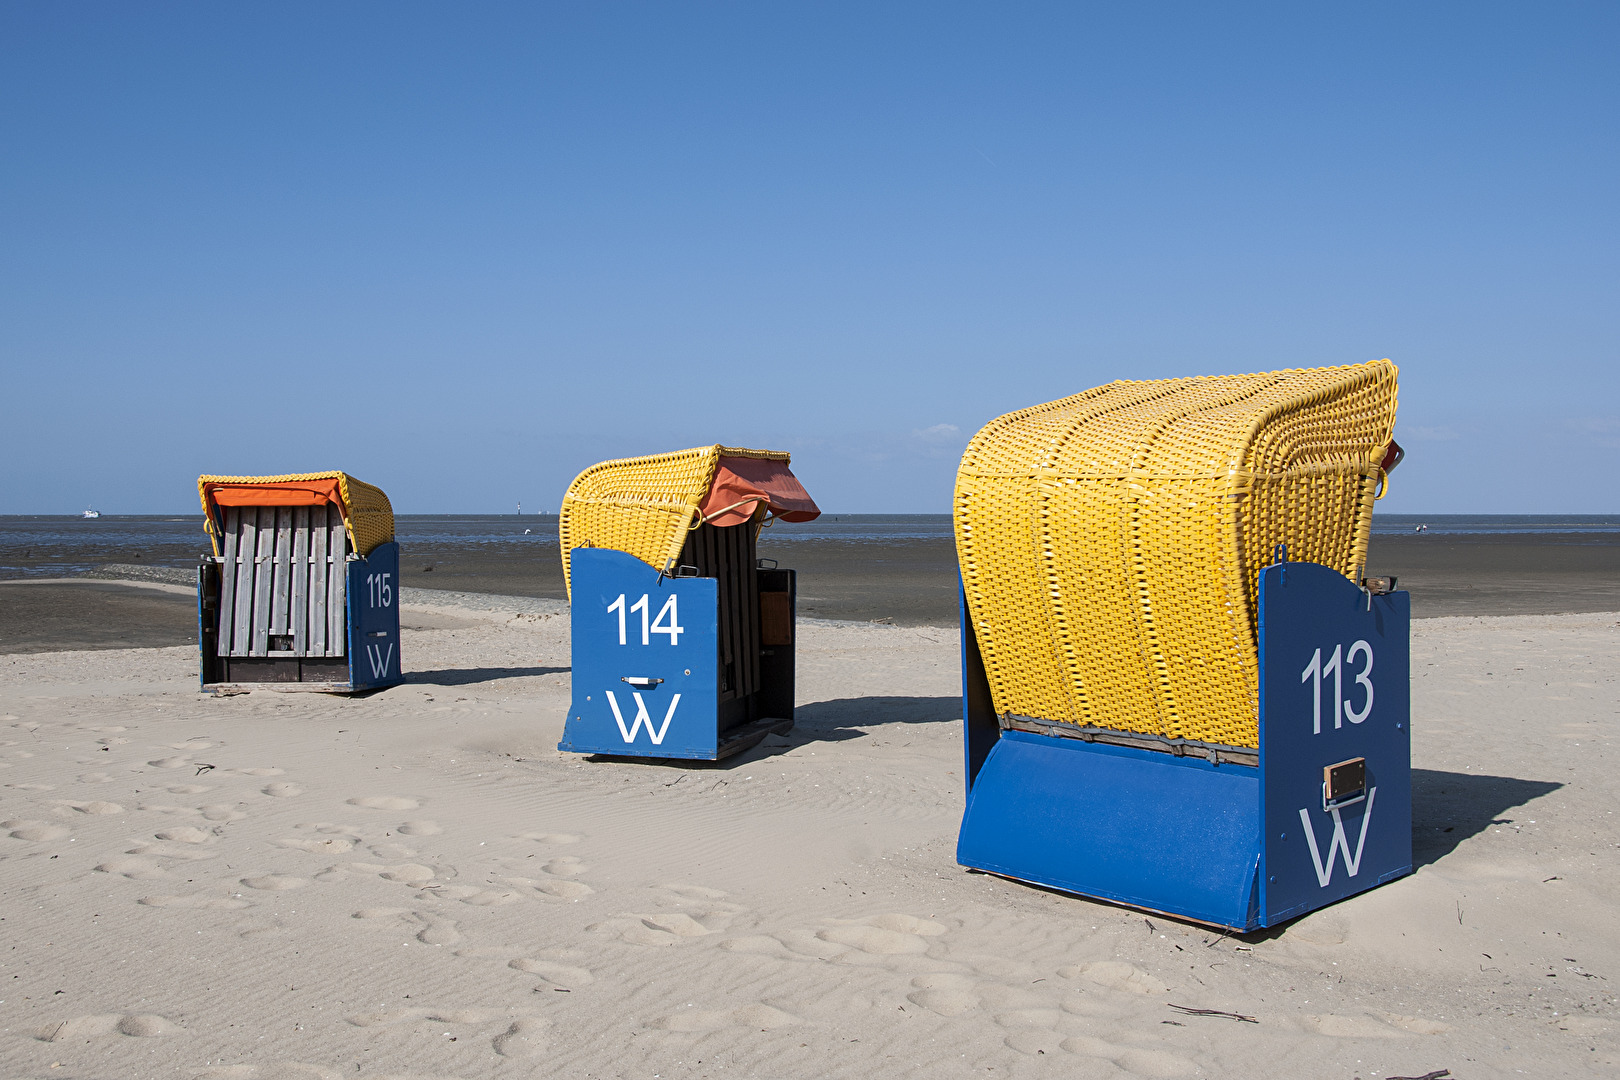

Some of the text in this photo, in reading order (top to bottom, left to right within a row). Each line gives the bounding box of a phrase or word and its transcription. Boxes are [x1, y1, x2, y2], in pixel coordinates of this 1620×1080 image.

[367, 573, 391, 608] 115
[607, 593, 684, 646] 114
[367, 643, 393, 679] W
[1301, 639, 1374, 735] 113
[605, 690, 681, 745] W
[1299, 786, 1377, 888] W
